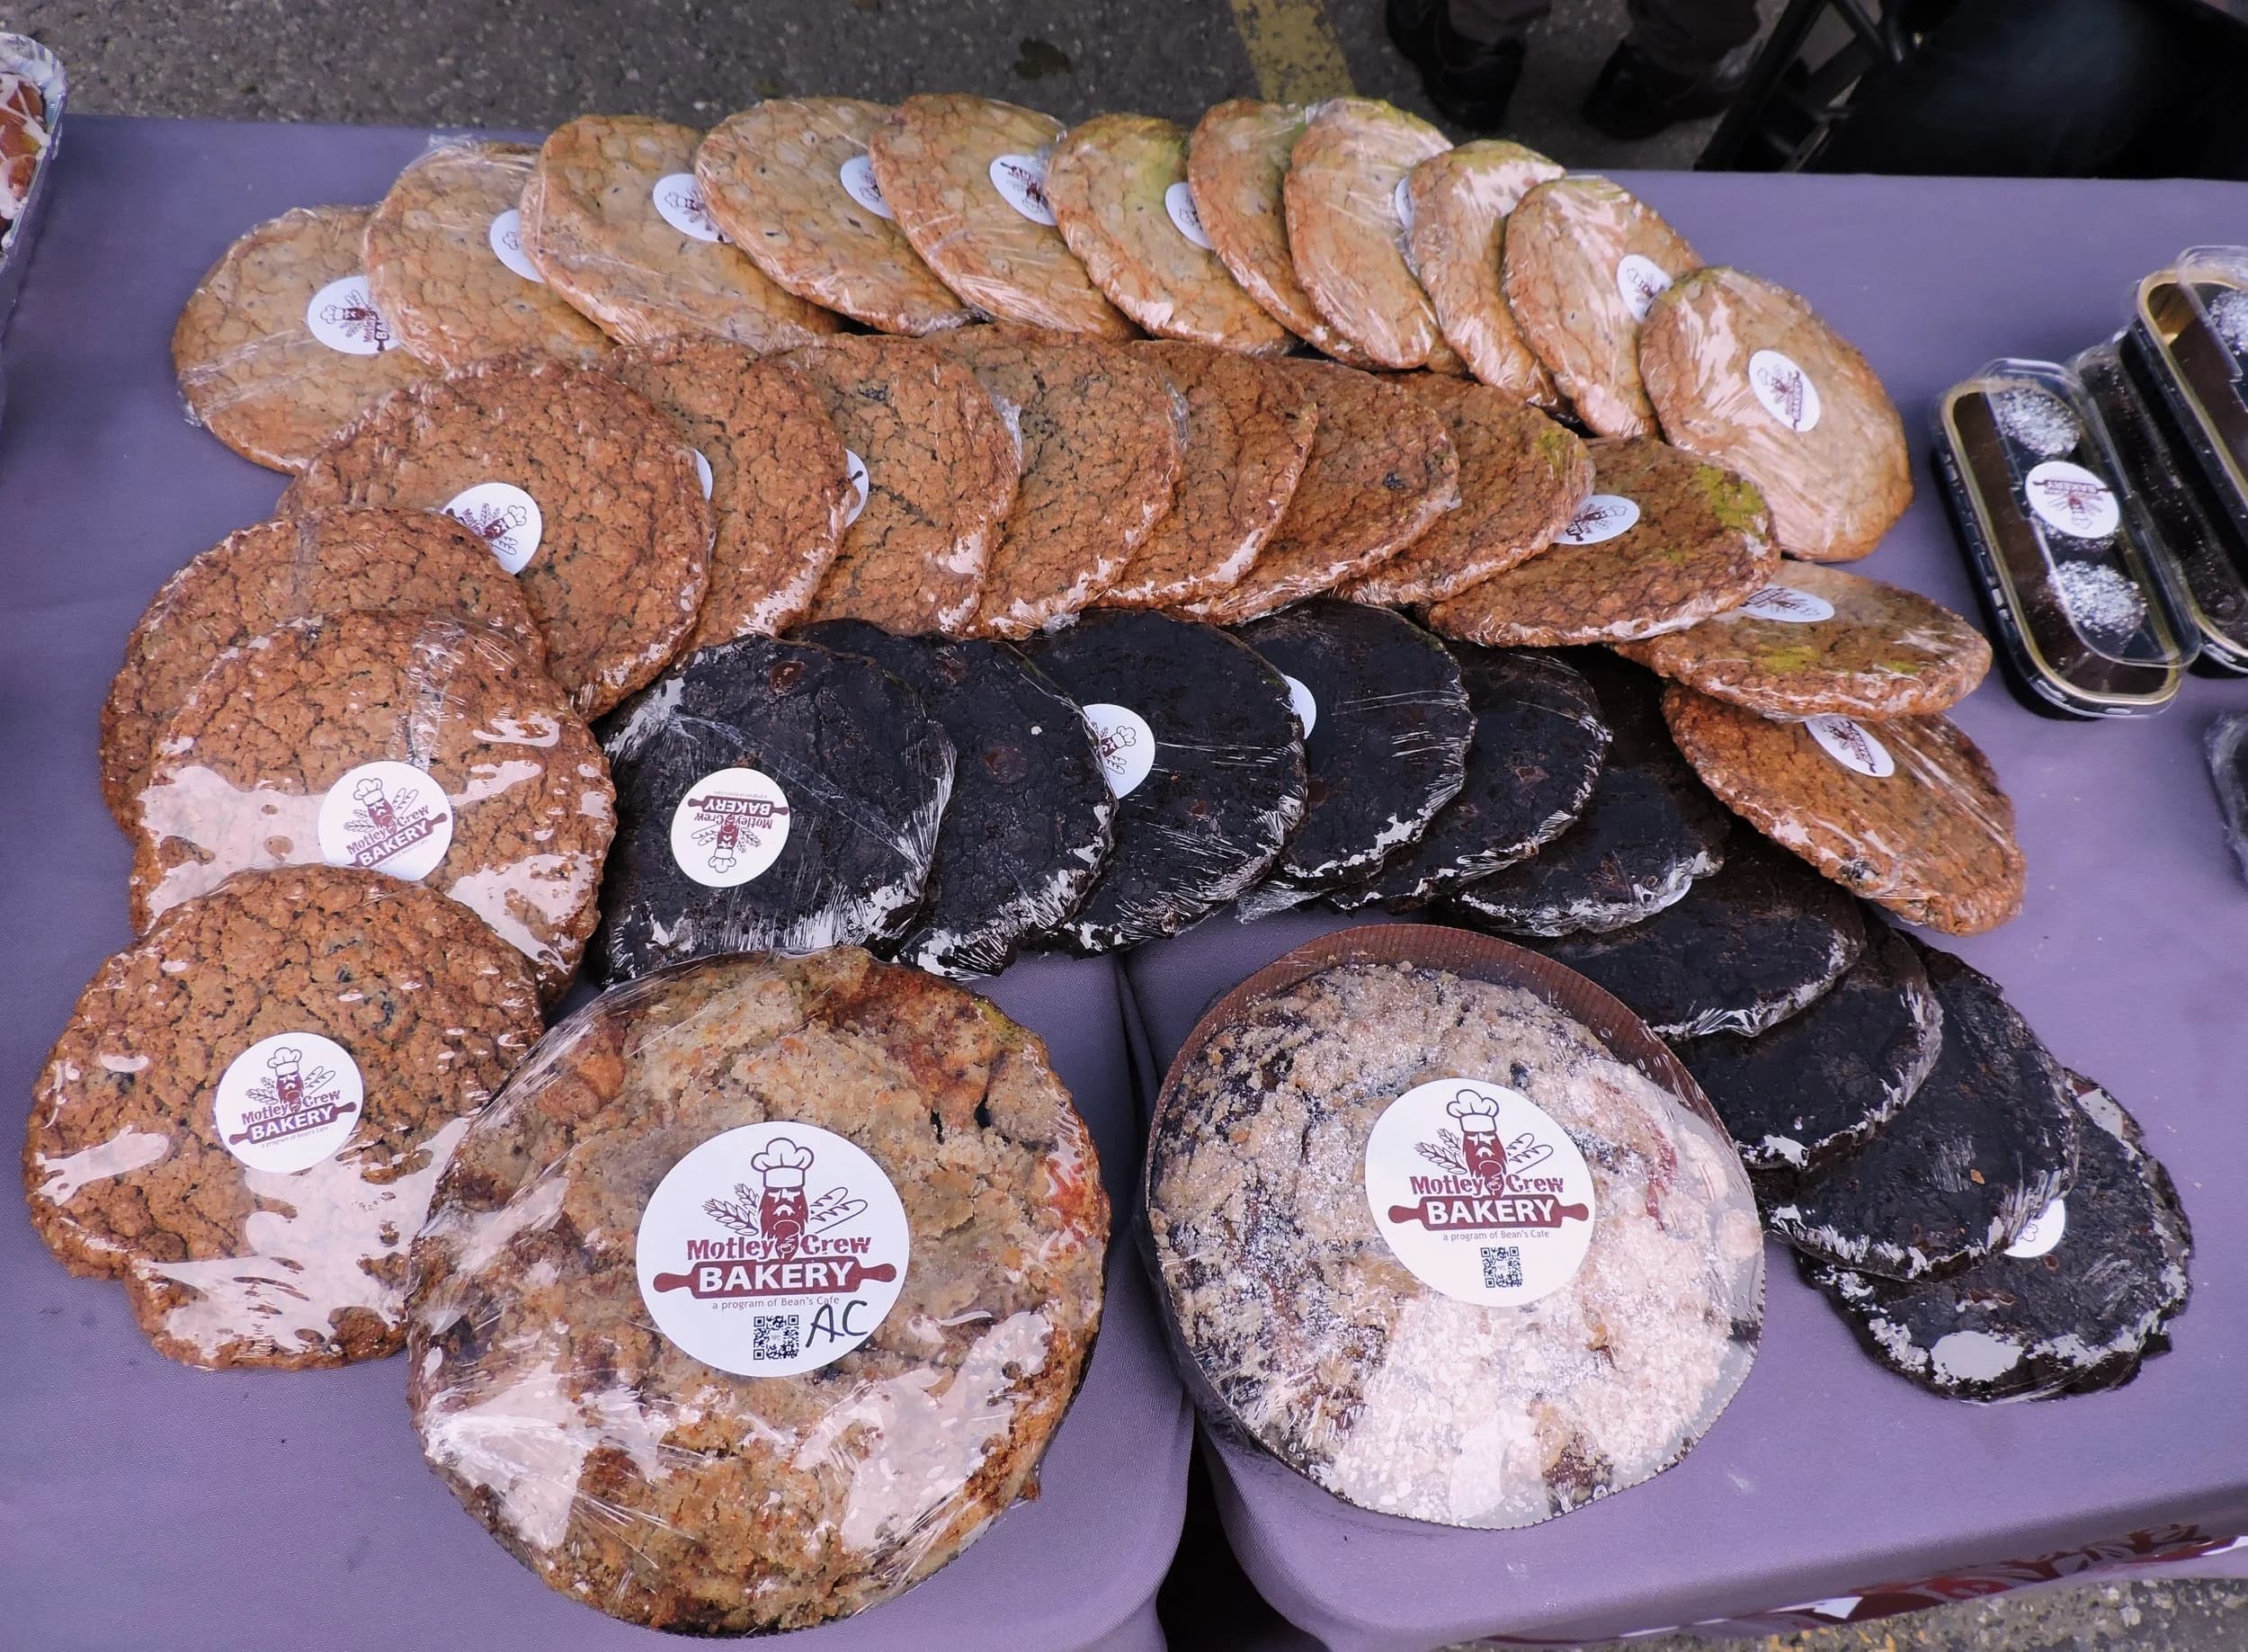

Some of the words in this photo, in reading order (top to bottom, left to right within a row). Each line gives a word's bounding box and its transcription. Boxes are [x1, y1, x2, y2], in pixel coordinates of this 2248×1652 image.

[693, 813, 724, 826] Crew
[704, 799, 772, 816] BAKERY
[346, 826, 387, 855] Motley
[397, 805, 430, 827] Crew
[736, 816, 773, 829] Motley
[359, 820, 428, 866] BAKERY
[241, 1103, 288, 1125] Motley
[302, 1090, 341, 1107] Crew
[250, 1105, 335, 1140] BAKERY
[1409, 1175, 1483, 1196] Motley
[1505, 1174, 1564, 1192] Crew
[1426, 1199, 1554, 1225] BAKERY
[686, 1237, 775, 1260] Motley
[800, 1234, 871, 1255] Crew
[1450, 1232, 1487, 1242] program
[1489, 1230, 1498, 1239] of
[1501, 1229, 1529, 1238] Bean's
[1530, 1229, 1549, 1238] Cafe
[699, 1262, 854, 1292] BAKERY
[721, 1299, 764, 1310] program
[768, 1298, 777, 1307] of
[781, 1297, 814, 1307] Bean's
[816, 1296, 840, 1305] Cafe
[806, 1300, 868, 1347] AC
